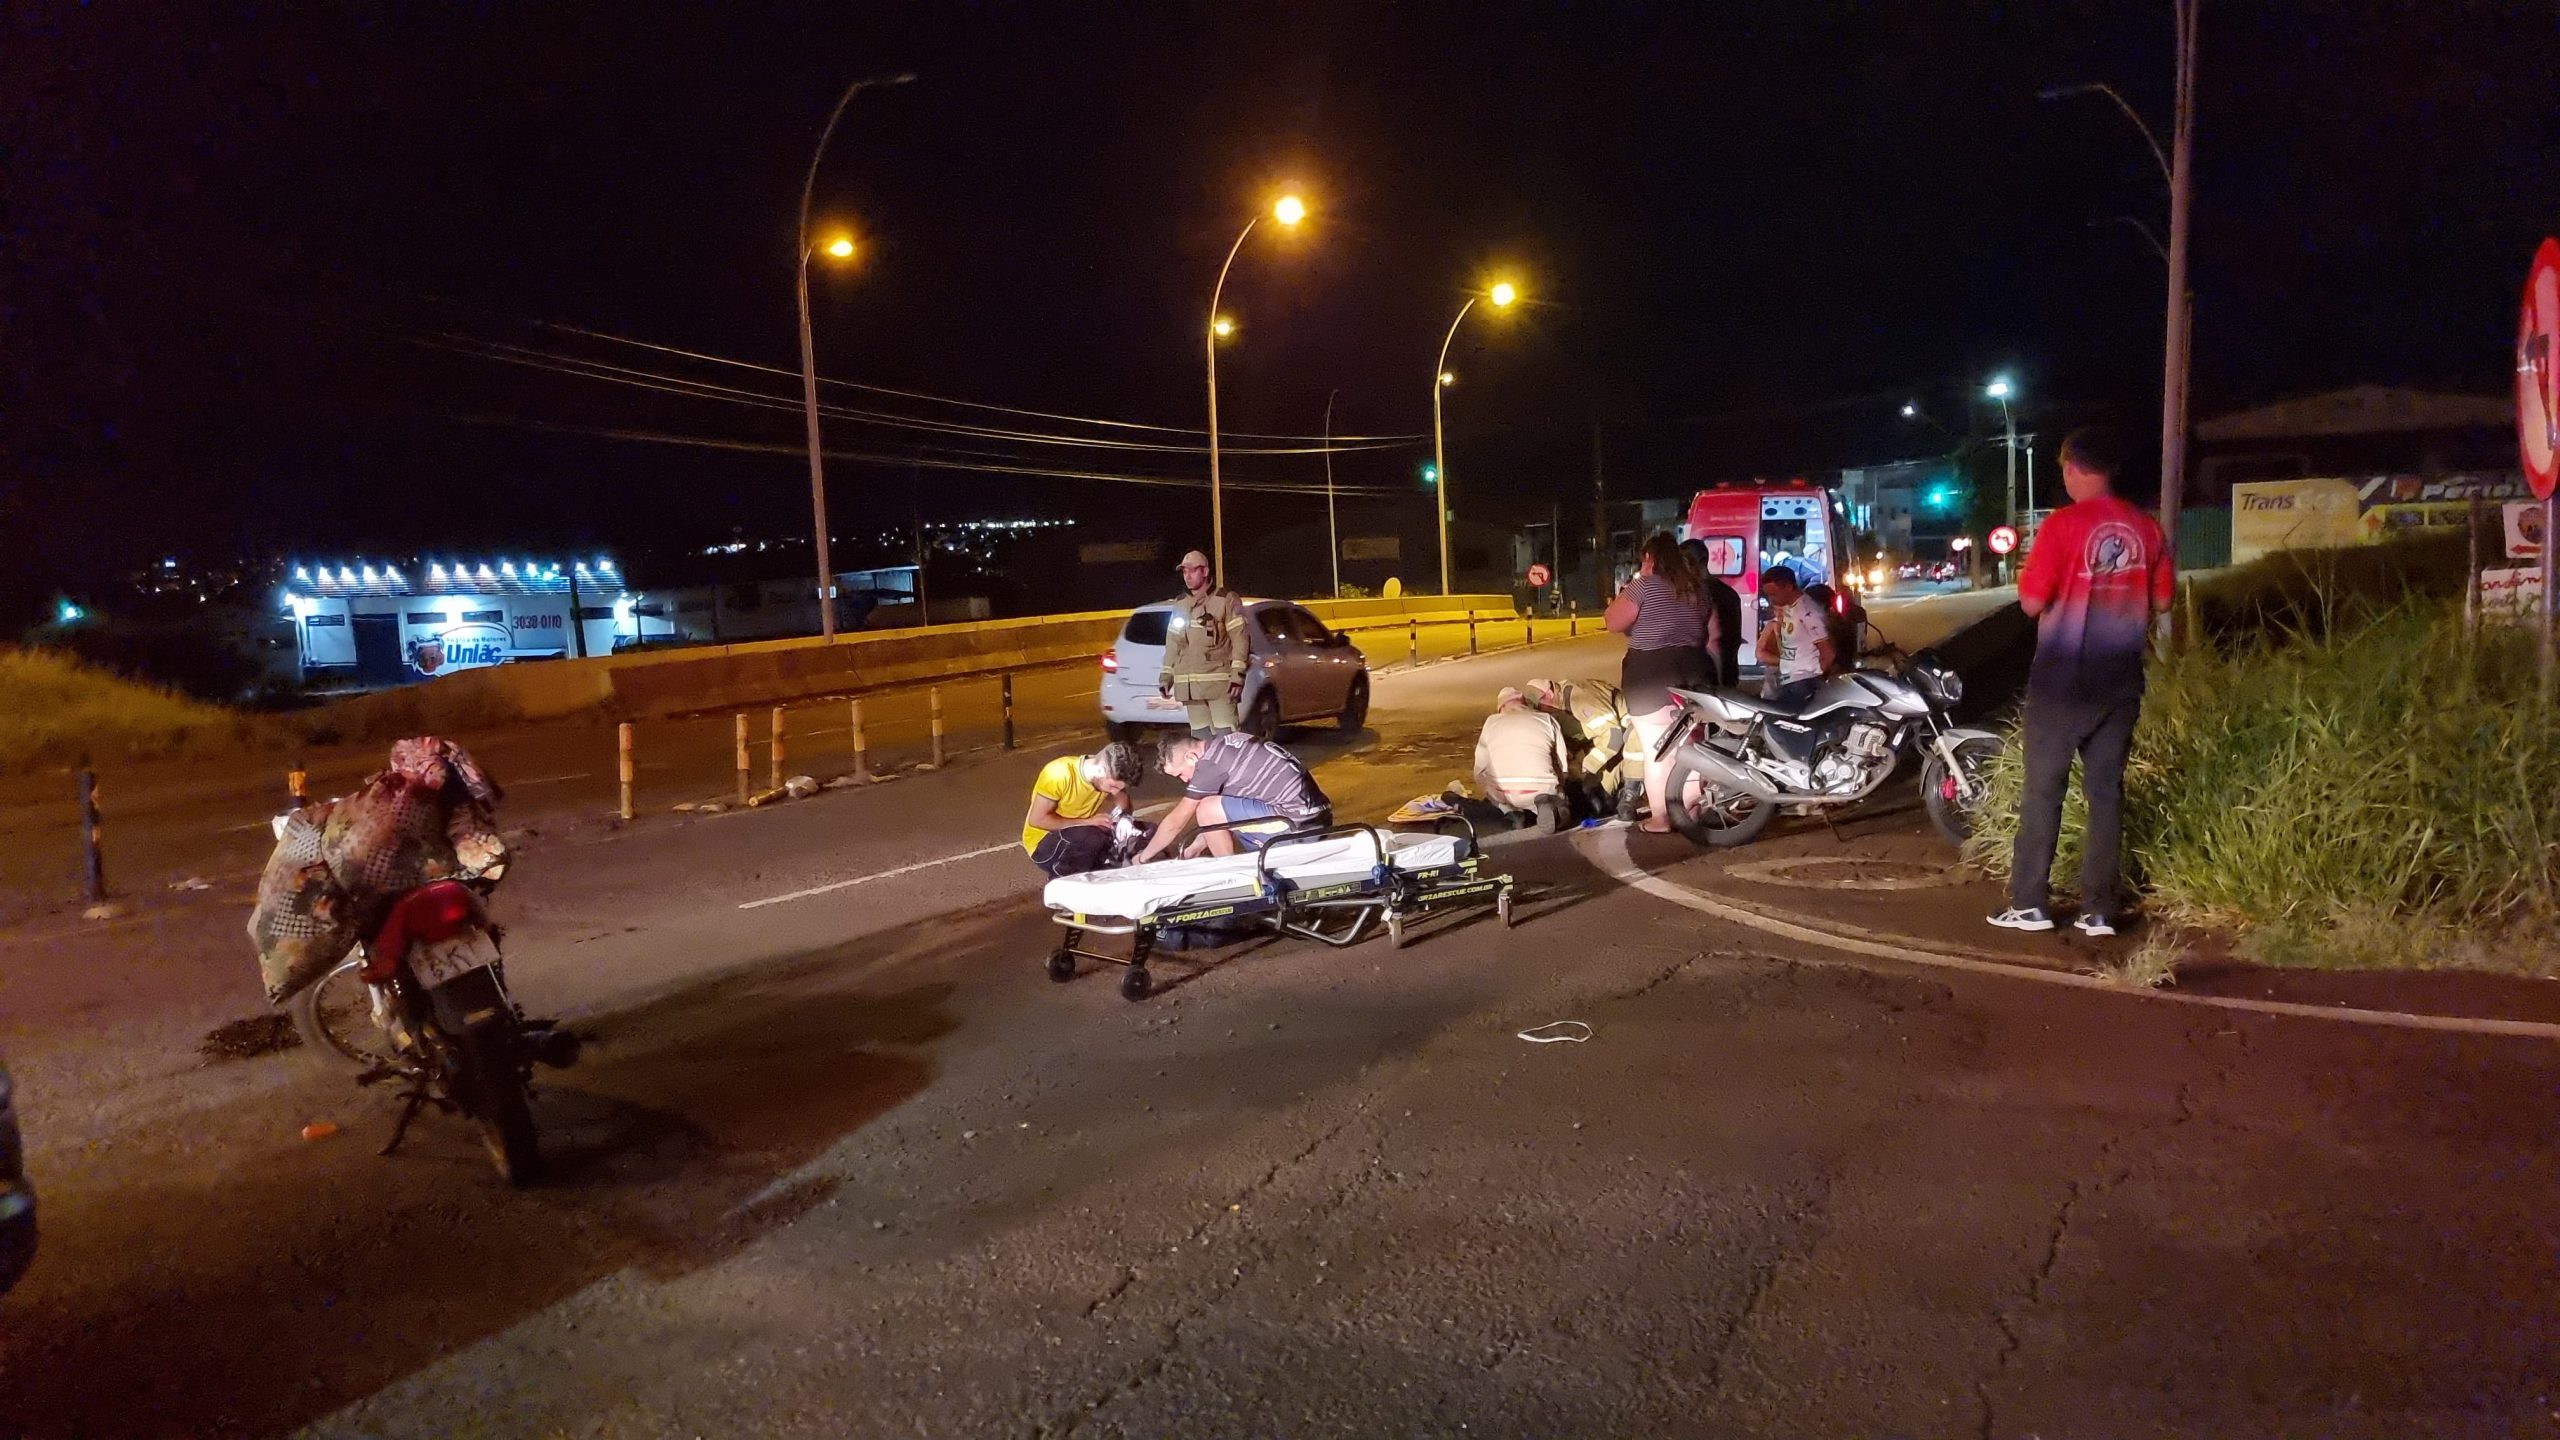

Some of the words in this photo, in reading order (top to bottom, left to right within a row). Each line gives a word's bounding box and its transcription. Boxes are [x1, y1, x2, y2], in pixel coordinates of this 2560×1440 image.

[2241, 492, 2295, 511] Trans
[1417, 869, 1440, 880] FR-R1
[1417, 884, 1495, 901] ORZARESCUE.COM.BR
[1175, 911, 1210, 923] FORZA
